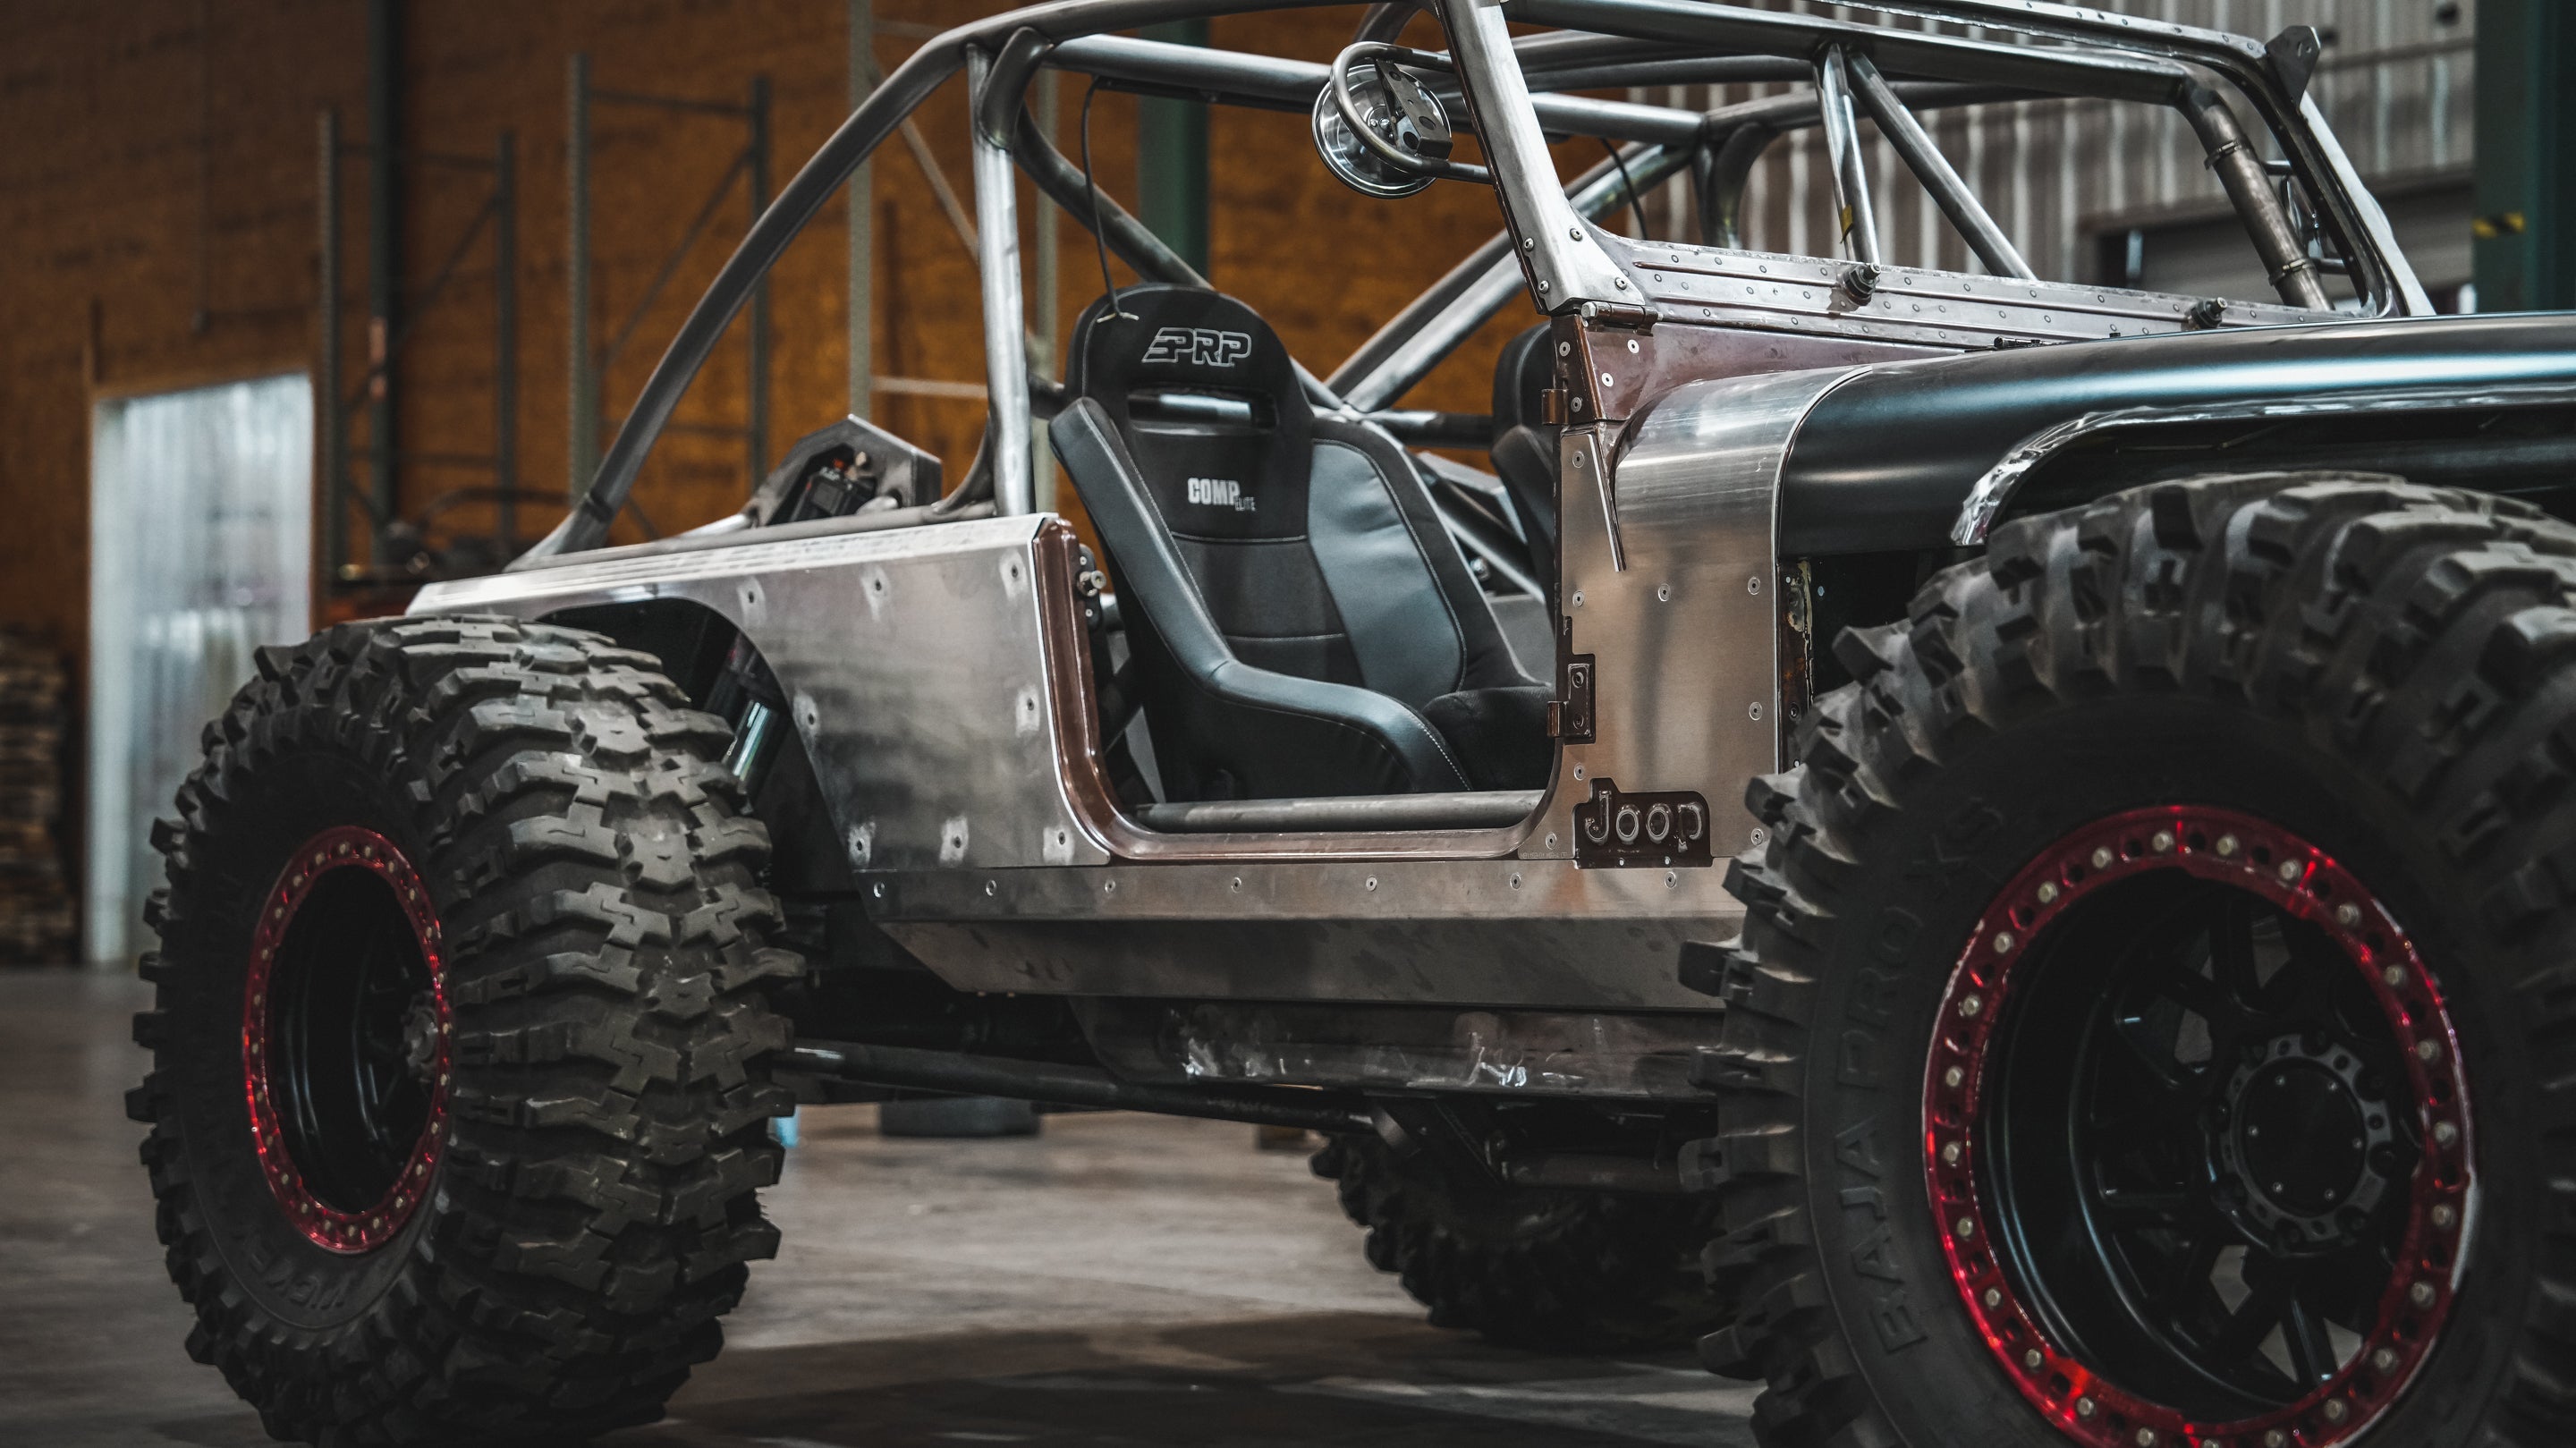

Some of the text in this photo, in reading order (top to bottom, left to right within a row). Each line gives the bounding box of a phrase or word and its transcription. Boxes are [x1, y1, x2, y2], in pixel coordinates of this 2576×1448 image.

[1141, 327, 1252, 368] PRP
[1188, 478, 1241, 505] COMP
[1836, 905, 1924, 1090] PRO
[1835, 1114, 1929, 1356] BAJA
